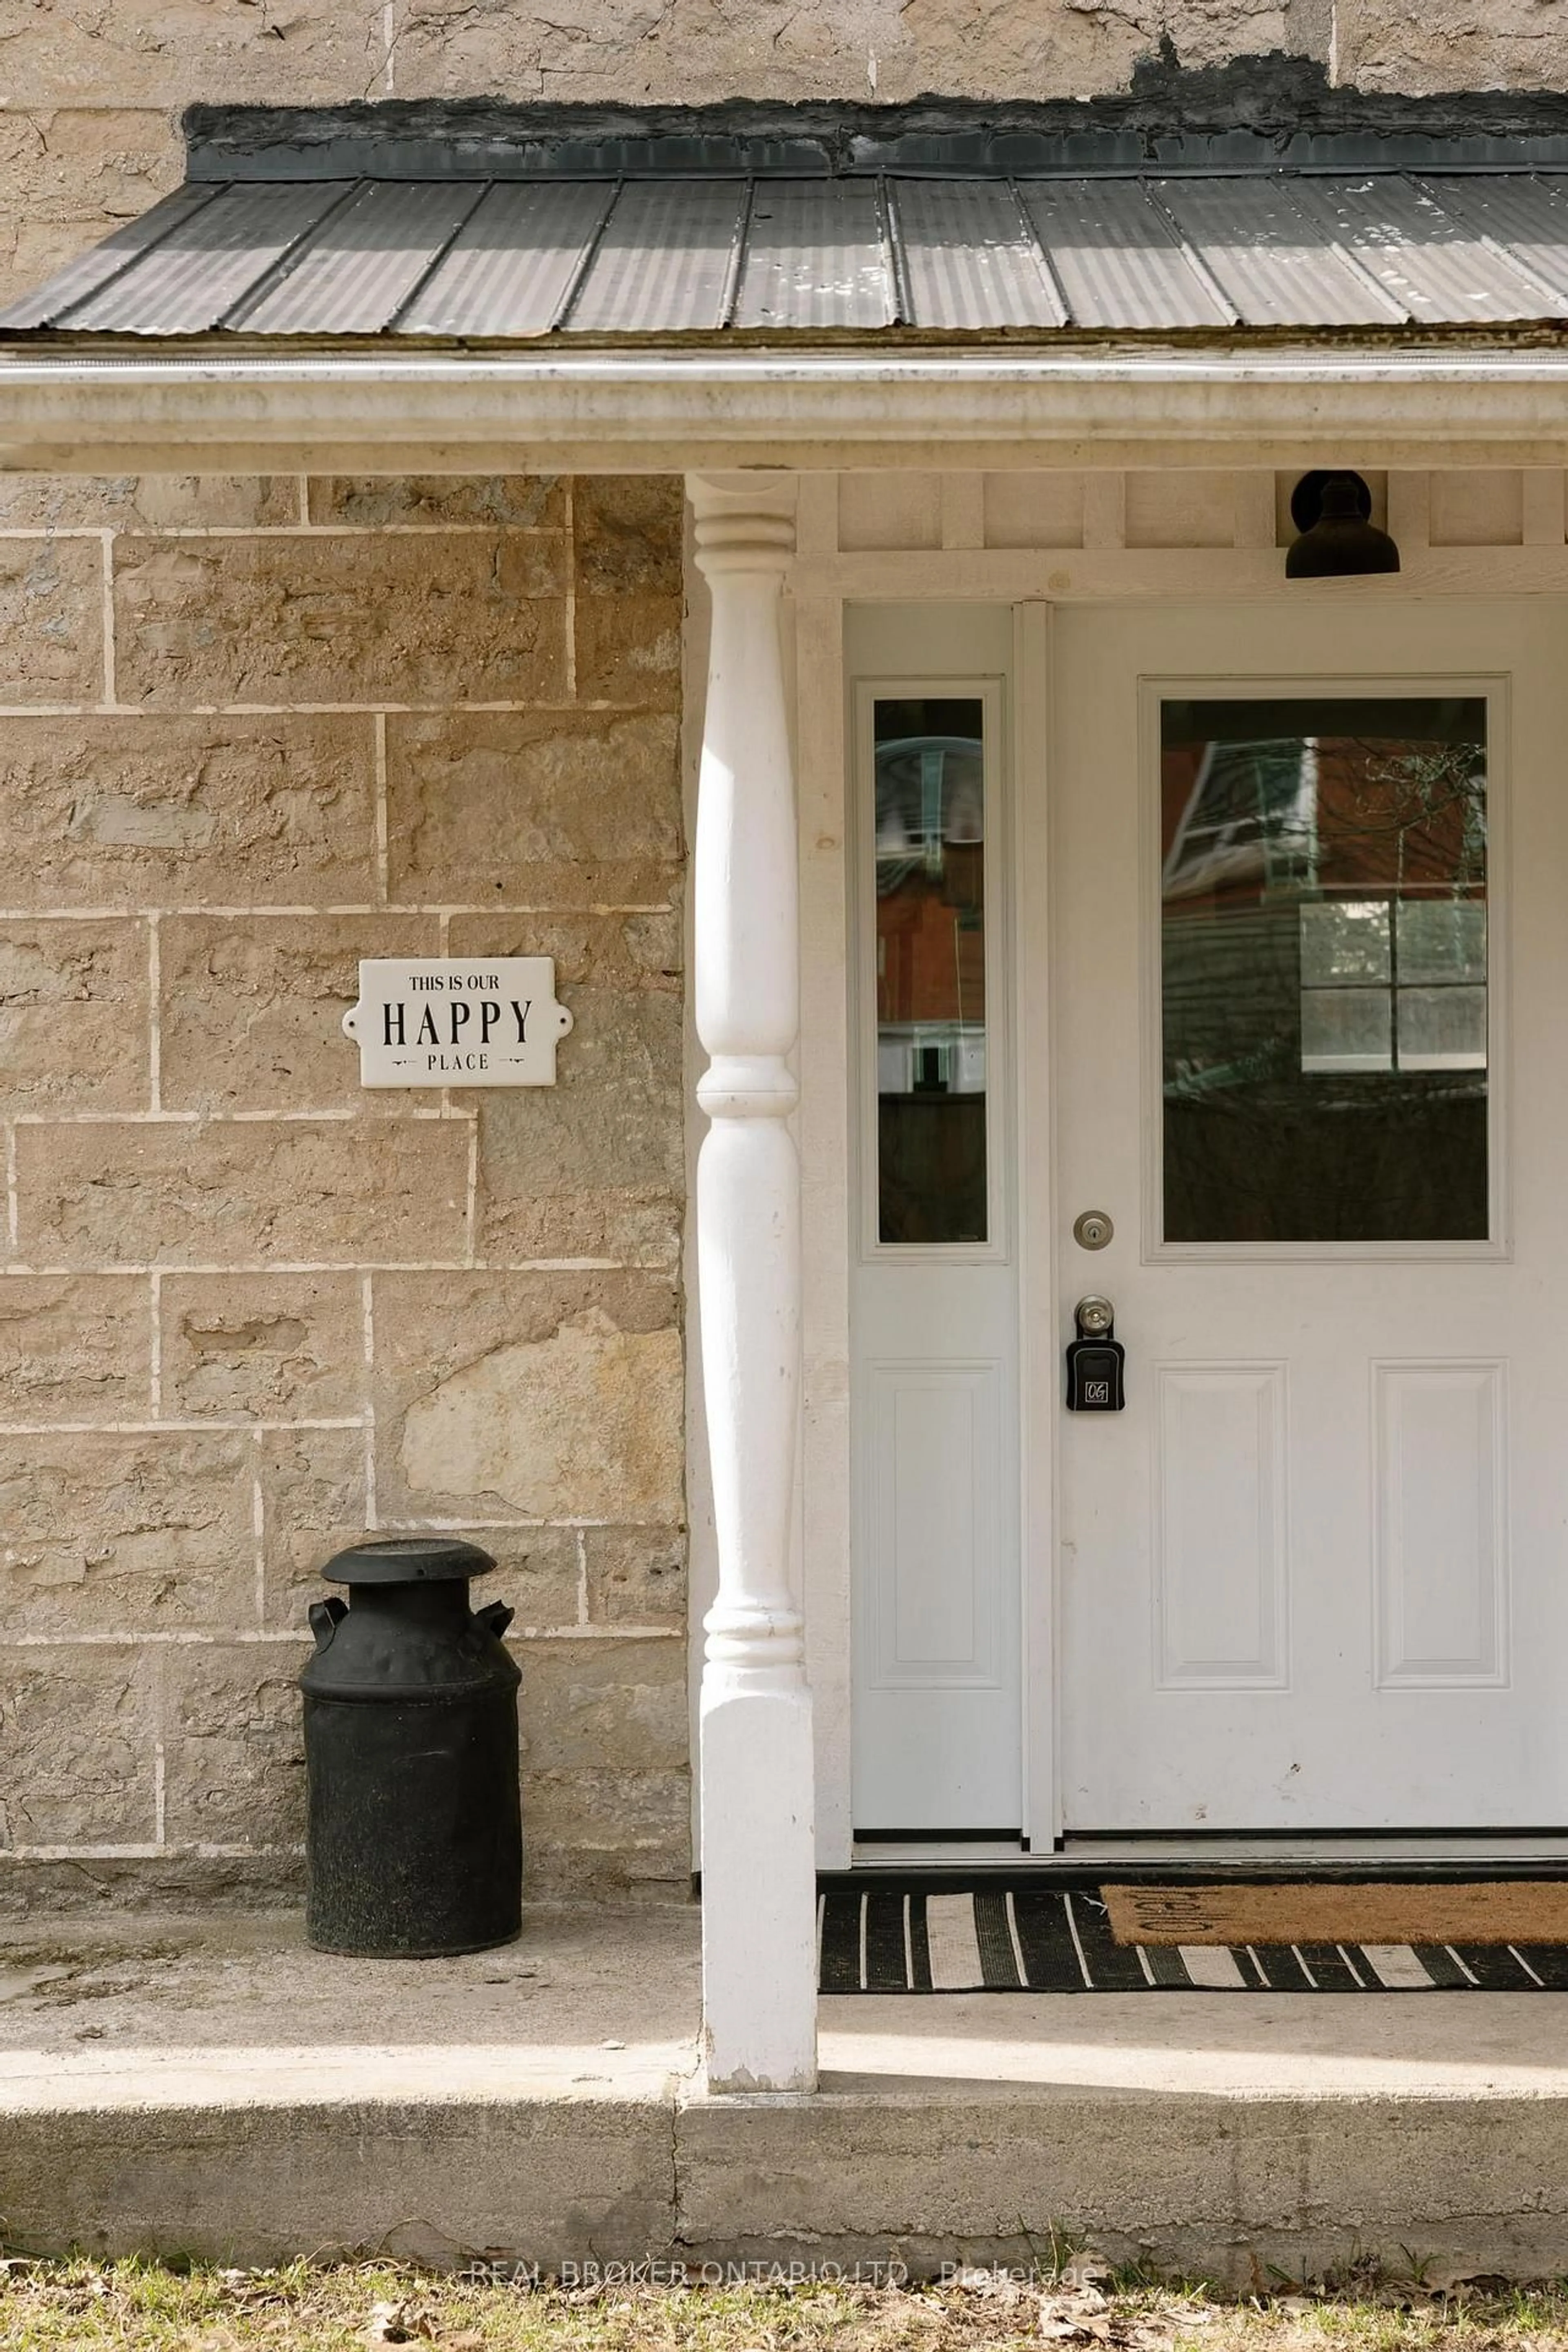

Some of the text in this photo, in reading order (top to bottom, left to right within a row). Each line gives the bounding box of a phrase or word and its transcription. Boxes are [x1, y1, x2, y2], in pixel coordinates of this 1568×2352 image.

[409, 975, 499, 991] THIS IS OUR
[382, 1000, 532, 1046] HAPPY
[428, 1053, 489, 1071] PLACE
[1129, 1891, 1235, 1933] hello
